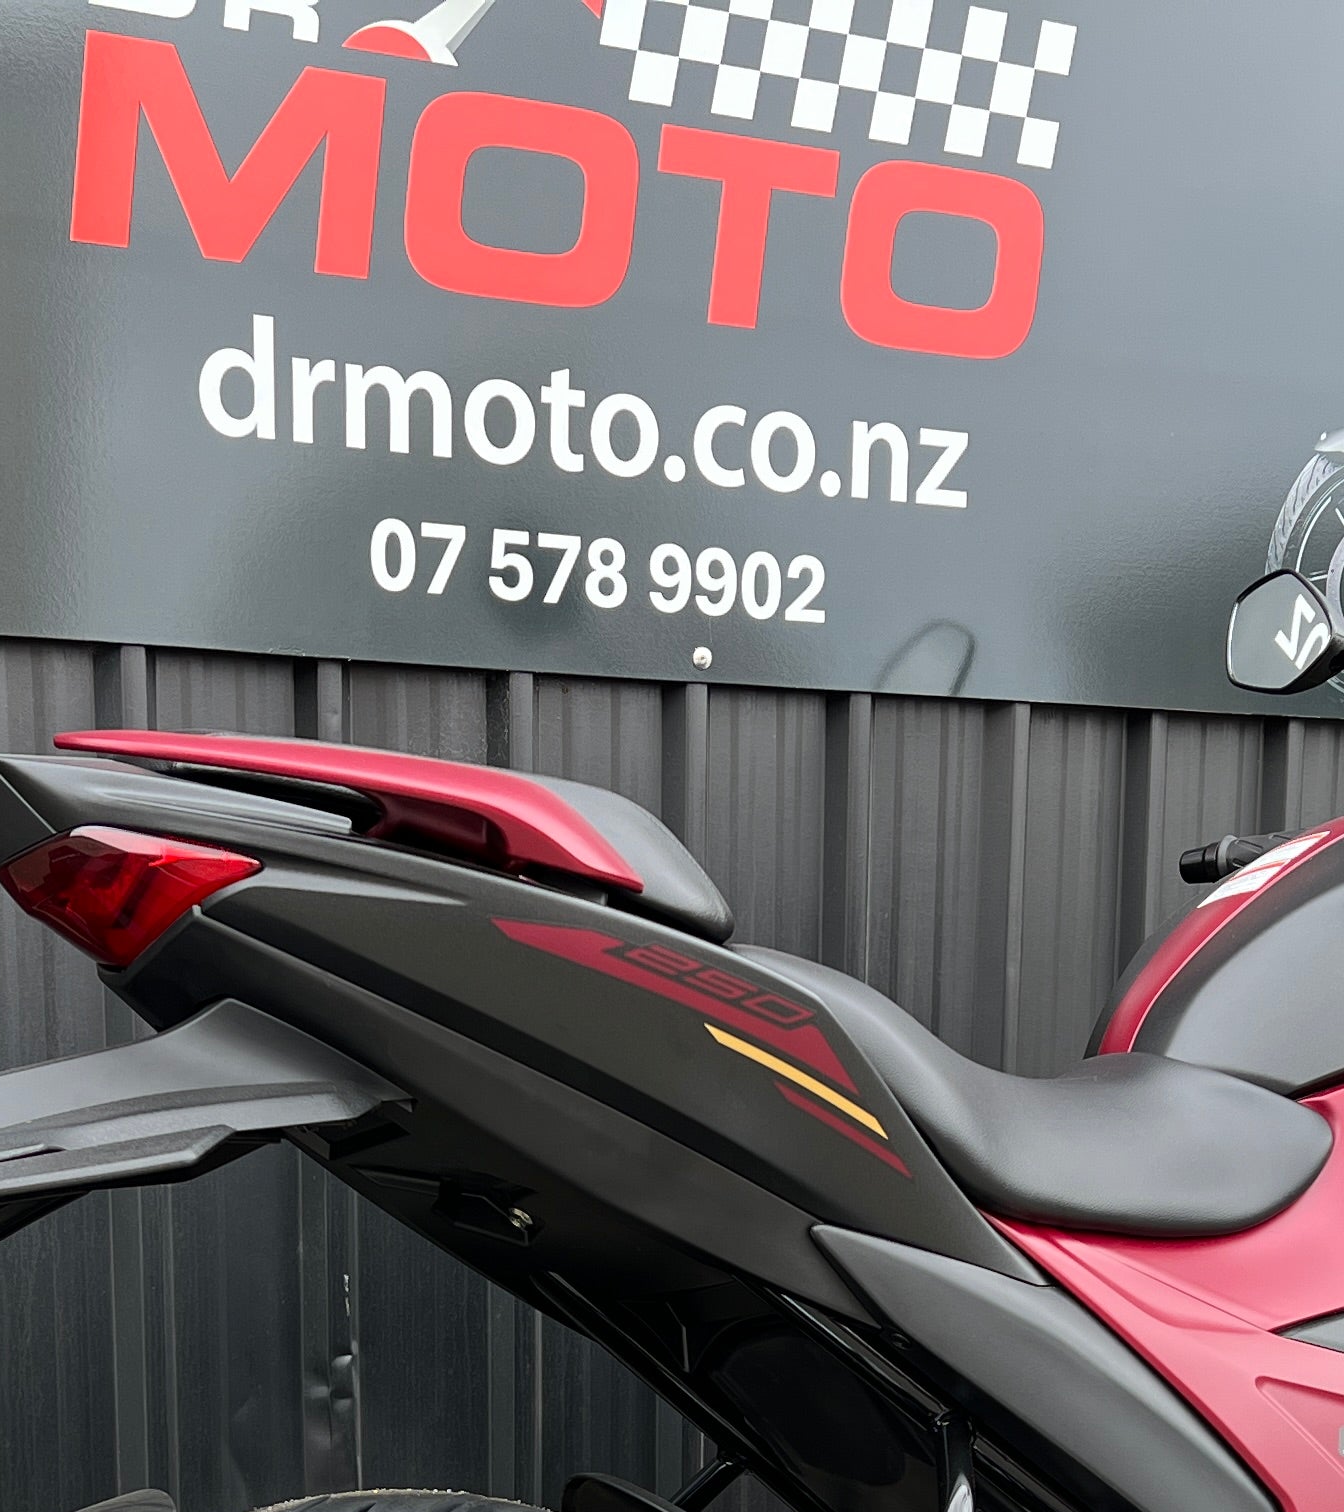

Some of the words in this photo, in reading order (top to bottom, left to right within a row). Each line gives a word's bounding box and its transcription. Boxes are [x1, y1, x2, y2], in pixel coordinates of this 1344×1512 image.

[70, 30, 1045, 360] MOTO
[197, 314, 970, 509] drmoto.co.nz
[369, 518, 467, 594] 07
[487, 527, 626, 608] 578
[648, 543, 826, 624] 9902
[625, 944, 816, 1025] 250
